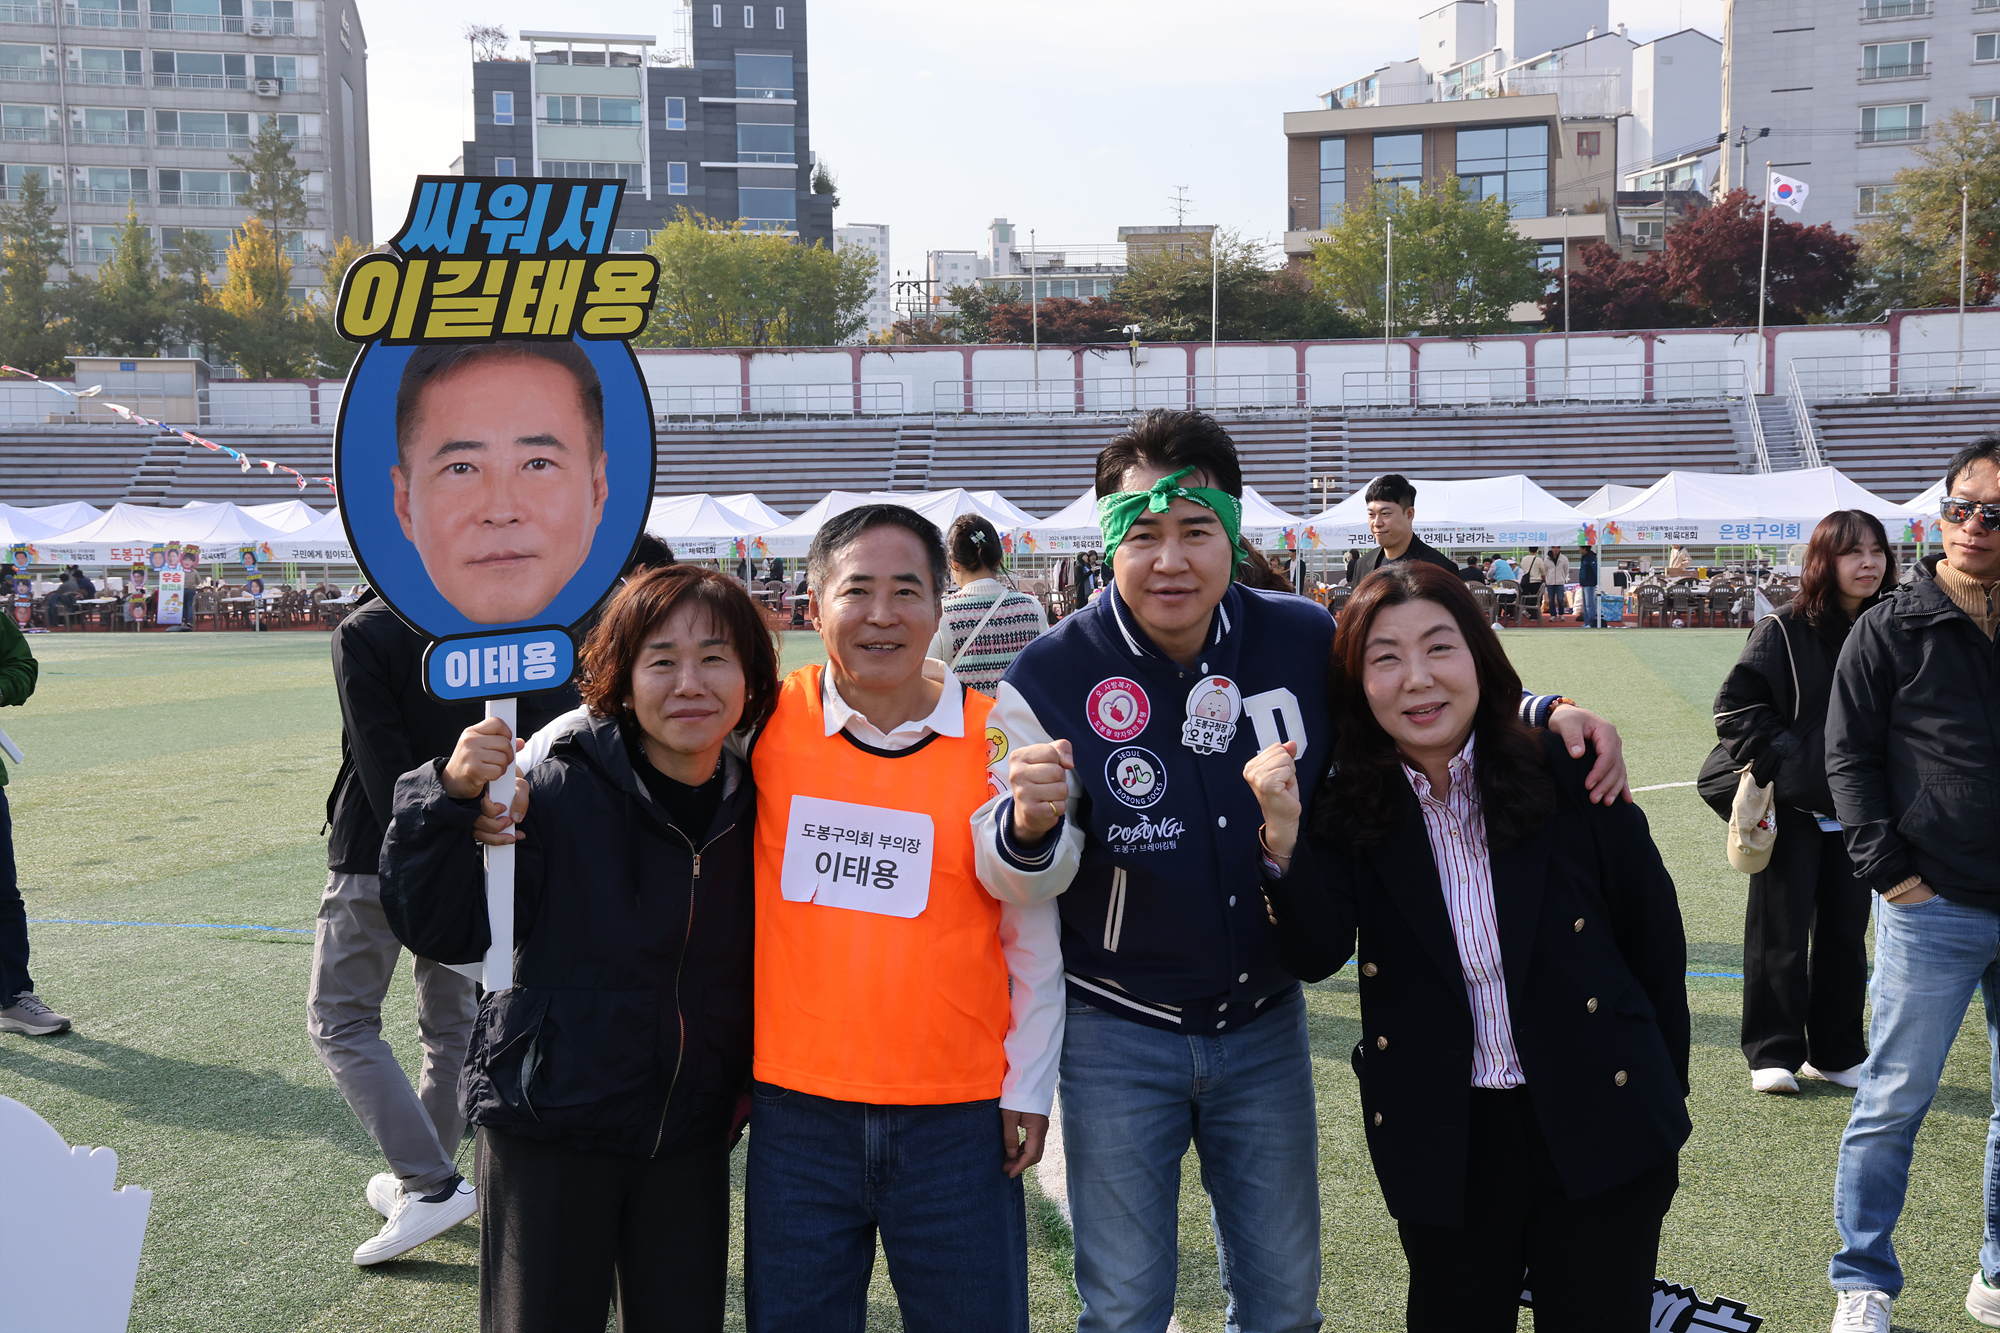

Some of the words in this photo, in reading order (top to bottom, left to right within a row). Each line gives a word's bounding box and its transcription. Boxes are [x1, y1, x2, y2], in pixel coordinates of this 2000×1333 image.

[398, 182, 621, 255] 싸워서
[342, 259, 652, 340] 이길태용
[1348, 534, 1377, 544] 구민의
[1424, 533, 1453, 543] 언제나
[1456, 533, 1496, 543] 달려가는
[1498, 532, 1548, 543] 은평구의회
[1664, 532, 1698, 540] 체육대회
[1719, 523, 1801, 540] 은평구의회
[1072, 541, 1102, 549] 체육대회
[292, 550, 323, 559] 구민에게
[162, 572, 182, 583] 우승
[444, 641, 557, 688] 이태용
[1194, 718, 1228, 734] 도봉구청장
[1242, 687, 1308, 760] D
[1117, 750, 1141, 760] SEOUL
[1116, 788, 1146, 805] DOBONG
[1147, 782, 1163, 802] SOCKS
[801, 823, 874, 847] 도봉구의회
[878, 834, 922, 854] 부의장
[1113, 844, 1137, 853] 도봉구
[815, 851, 899, 890] 이태용
